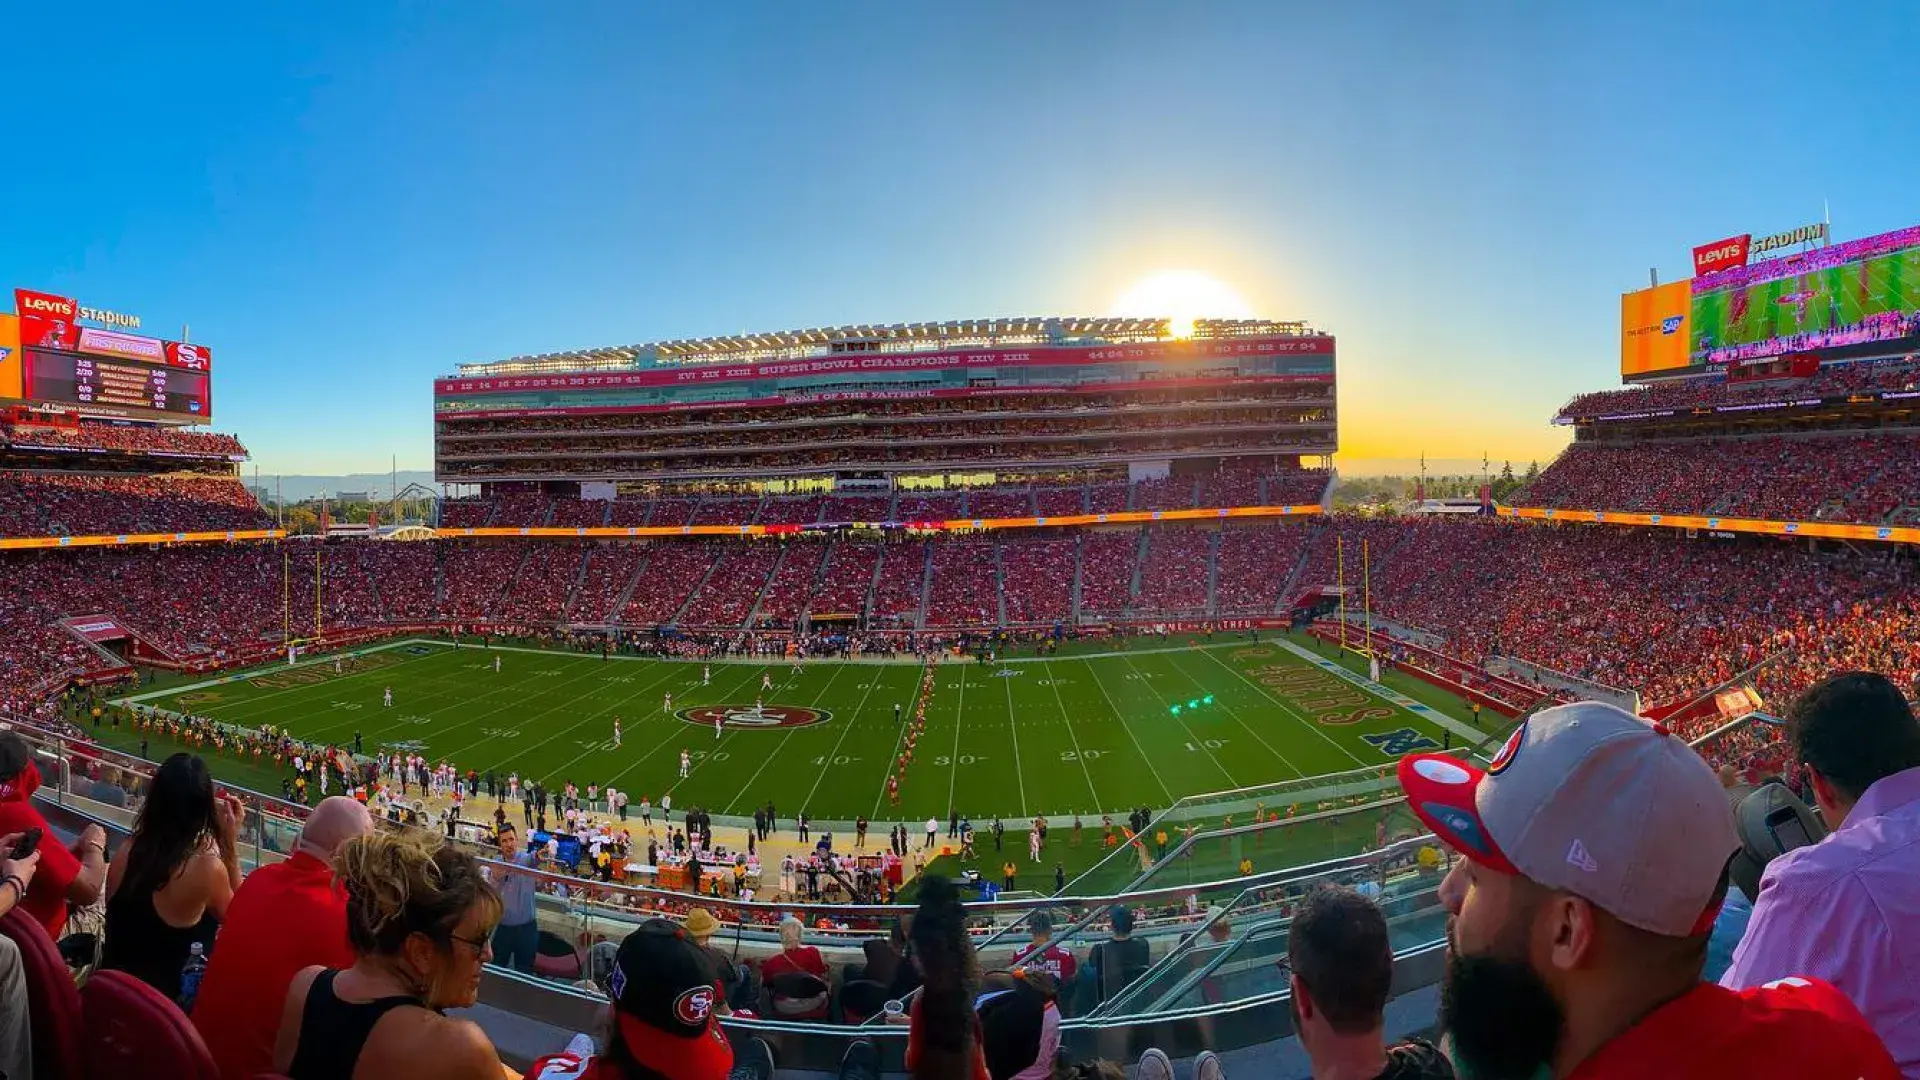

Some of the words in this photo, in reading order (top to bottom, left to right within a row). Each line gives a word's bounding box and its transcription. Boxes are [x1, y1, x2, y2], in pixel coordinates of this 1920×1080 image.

[1750, 223, 1824, 253] STADIUM
[80, 306, 141, 328] STADIUM
[1662, 318, 1681, 332] SAP
[967, 354, 996, 363] XXIV
[758, 363, 810, 375] SUPER
[811, 359, 859, 370] BOWL
[860, 355, 960, 368] CHAMPIONS
[842, 391, 867, 399] THE
[871, 390, 935, 399] FAITHFUL
[811, 755, 849, 766] 40
[934, 755, 976, 766] 30
[1060, 749, 1100, 761] 20
